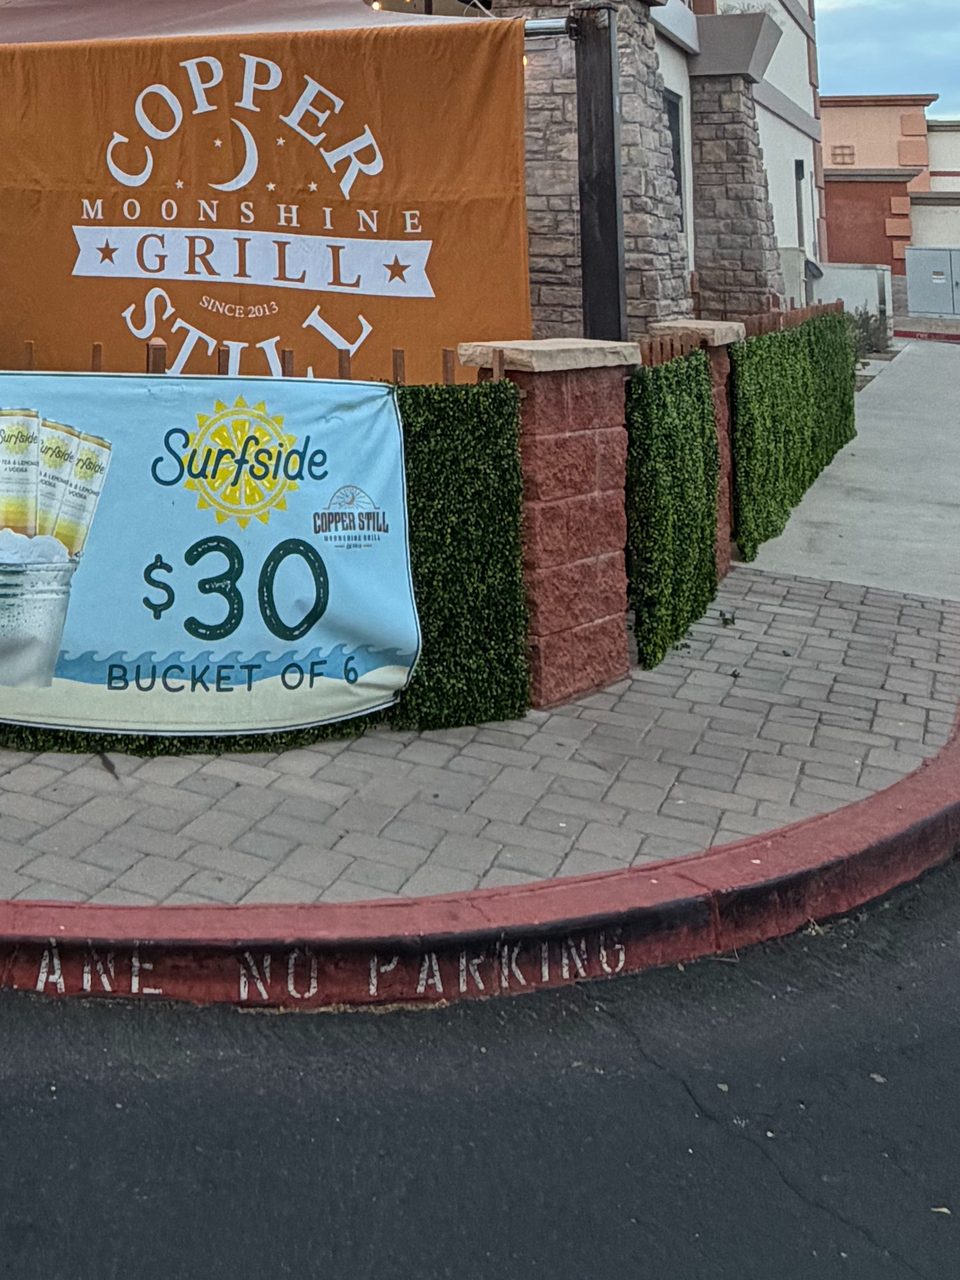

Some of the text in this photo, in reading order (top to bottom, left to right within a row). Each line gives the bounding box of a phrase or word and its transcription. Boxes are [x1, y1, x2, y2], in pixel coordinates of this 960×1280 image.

[106, 52, 384, 200] COPPER
[80, 198, 423, 234] MOONSHINE
[135, 234, 361, 288] GRILL
[199, 295, 279, 318] SINCE 2013
[40, 439, 74, 463] urfside
[151, 428, 328, 487] Surfside
[313, 511, 389, 534] COPPER STILL
[142, 535, 329, 641] $30
[107, 655, 359, 693] BUCKET OF 6
[239, 944, 319, 1001] NO
[368, 929, 627, 996] PARKING
